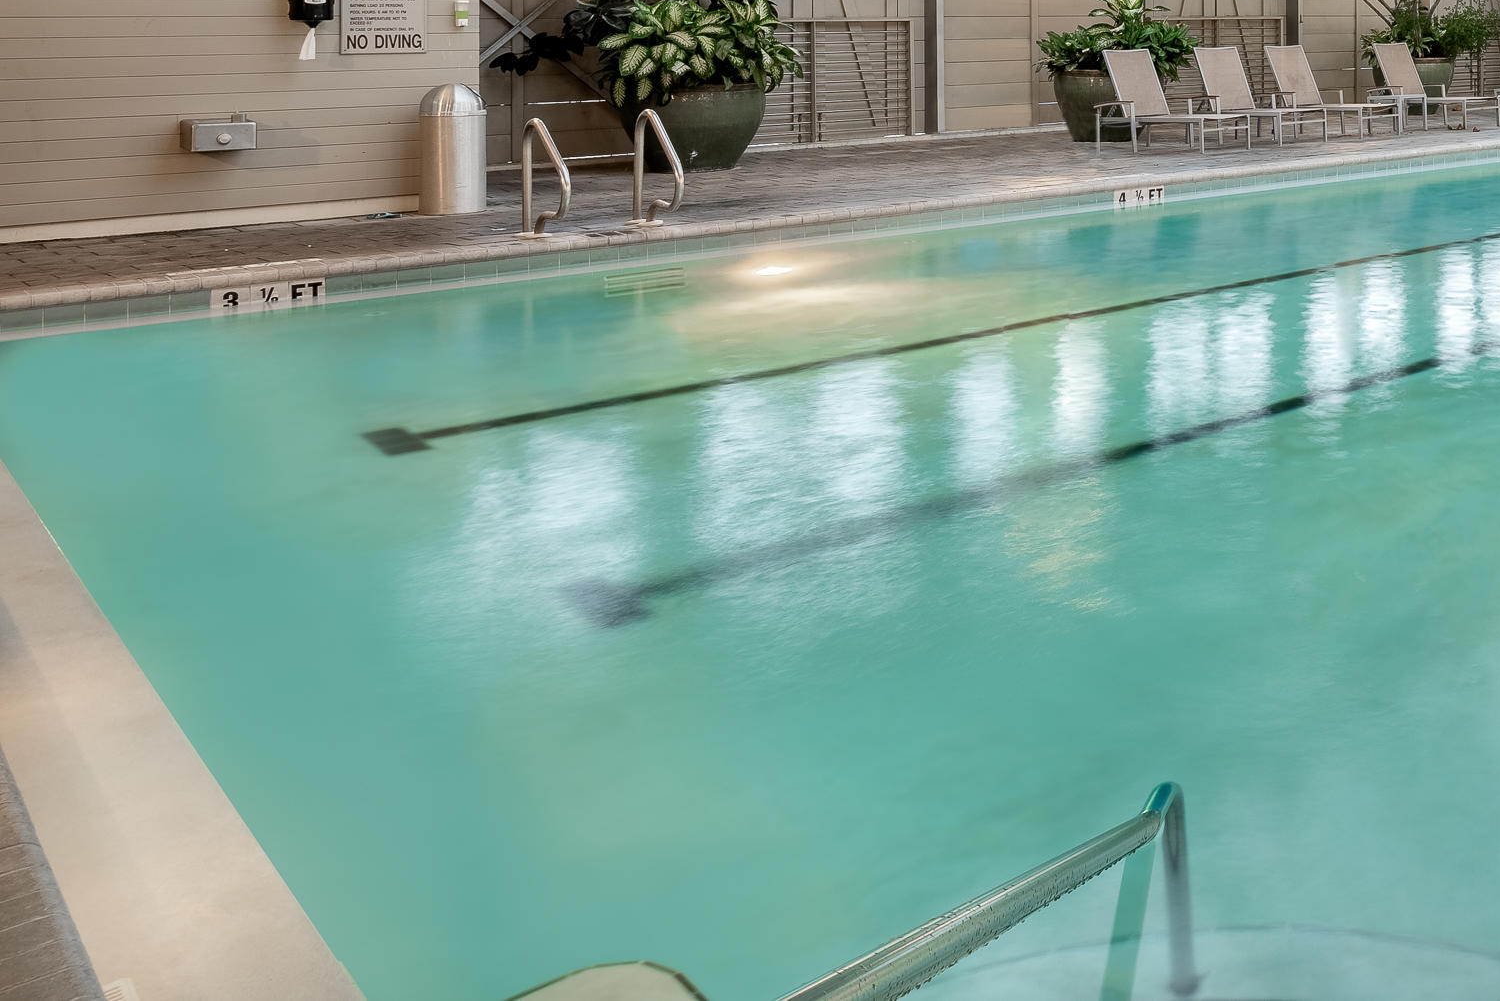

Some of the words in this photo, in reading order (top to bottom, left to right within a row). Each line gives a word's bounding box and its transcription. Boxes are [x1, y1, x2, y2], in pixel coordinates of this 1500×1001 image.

[346, 34, 368, 49] NO
[375, 34, 422, 49] DIVING
[1118, 192, 1126, 202] 4
[1149, 188, 1163, 199] FT
[222, 291, 239, 307] 3
[291, 281, 323, 300] FT
